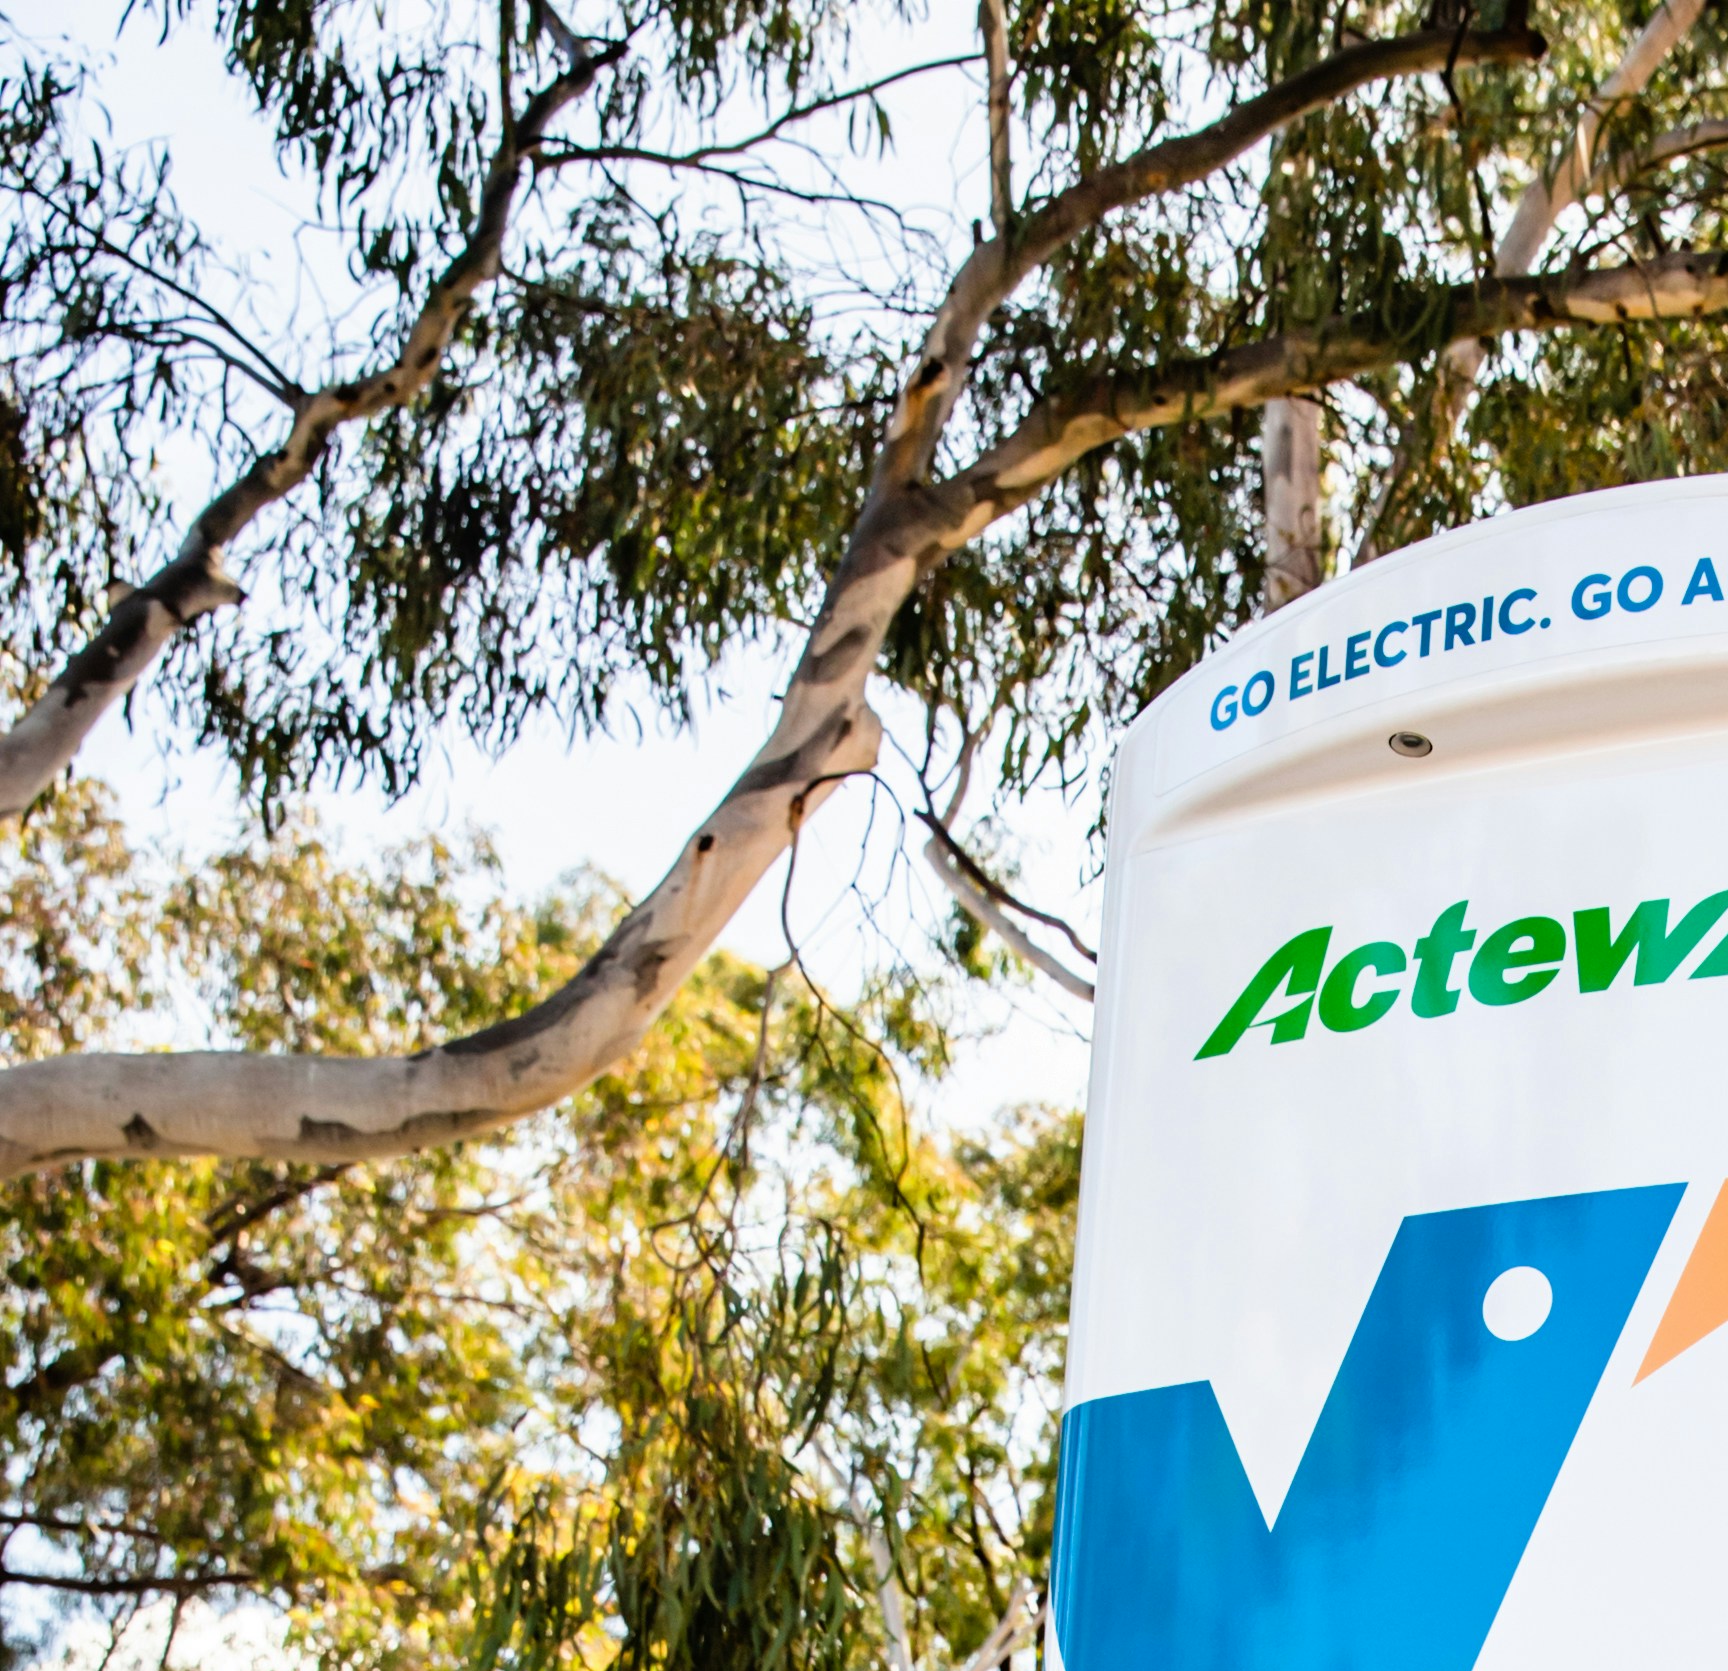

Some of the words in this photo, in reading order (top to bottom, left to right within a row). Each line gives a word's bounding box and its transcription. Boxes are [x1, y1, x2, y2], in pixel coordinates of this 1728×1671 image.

[1209, 670, 1276, 732] GO
[1288, 586, 1553, 702] ELECTRIC.
[1569, 565, 1665, 622] GO
